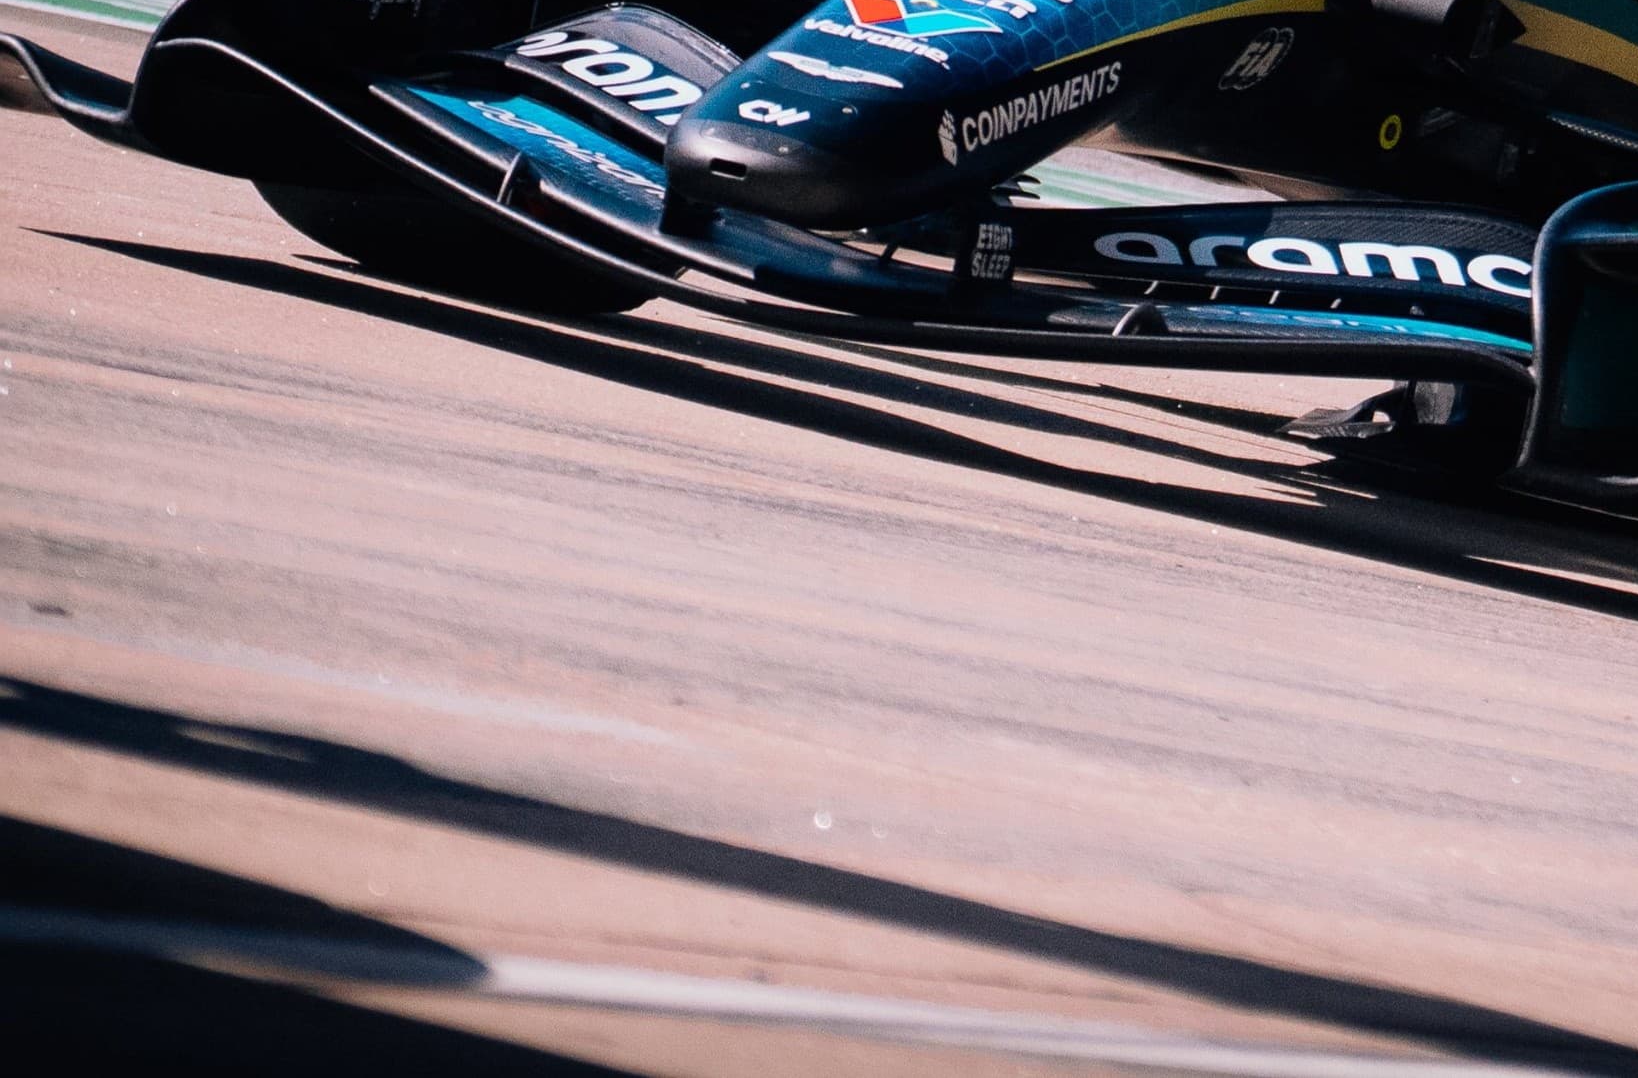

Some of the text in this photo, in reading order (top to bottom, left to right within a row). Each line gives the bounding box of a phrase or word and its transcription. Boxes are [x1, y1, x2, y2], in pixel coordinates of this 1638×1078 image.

[803, 18, 950, 70] Valvoline
[961, 60, 1123, 153] COINPAYMENTS
[1093, 231, 1533, 299] aramc
